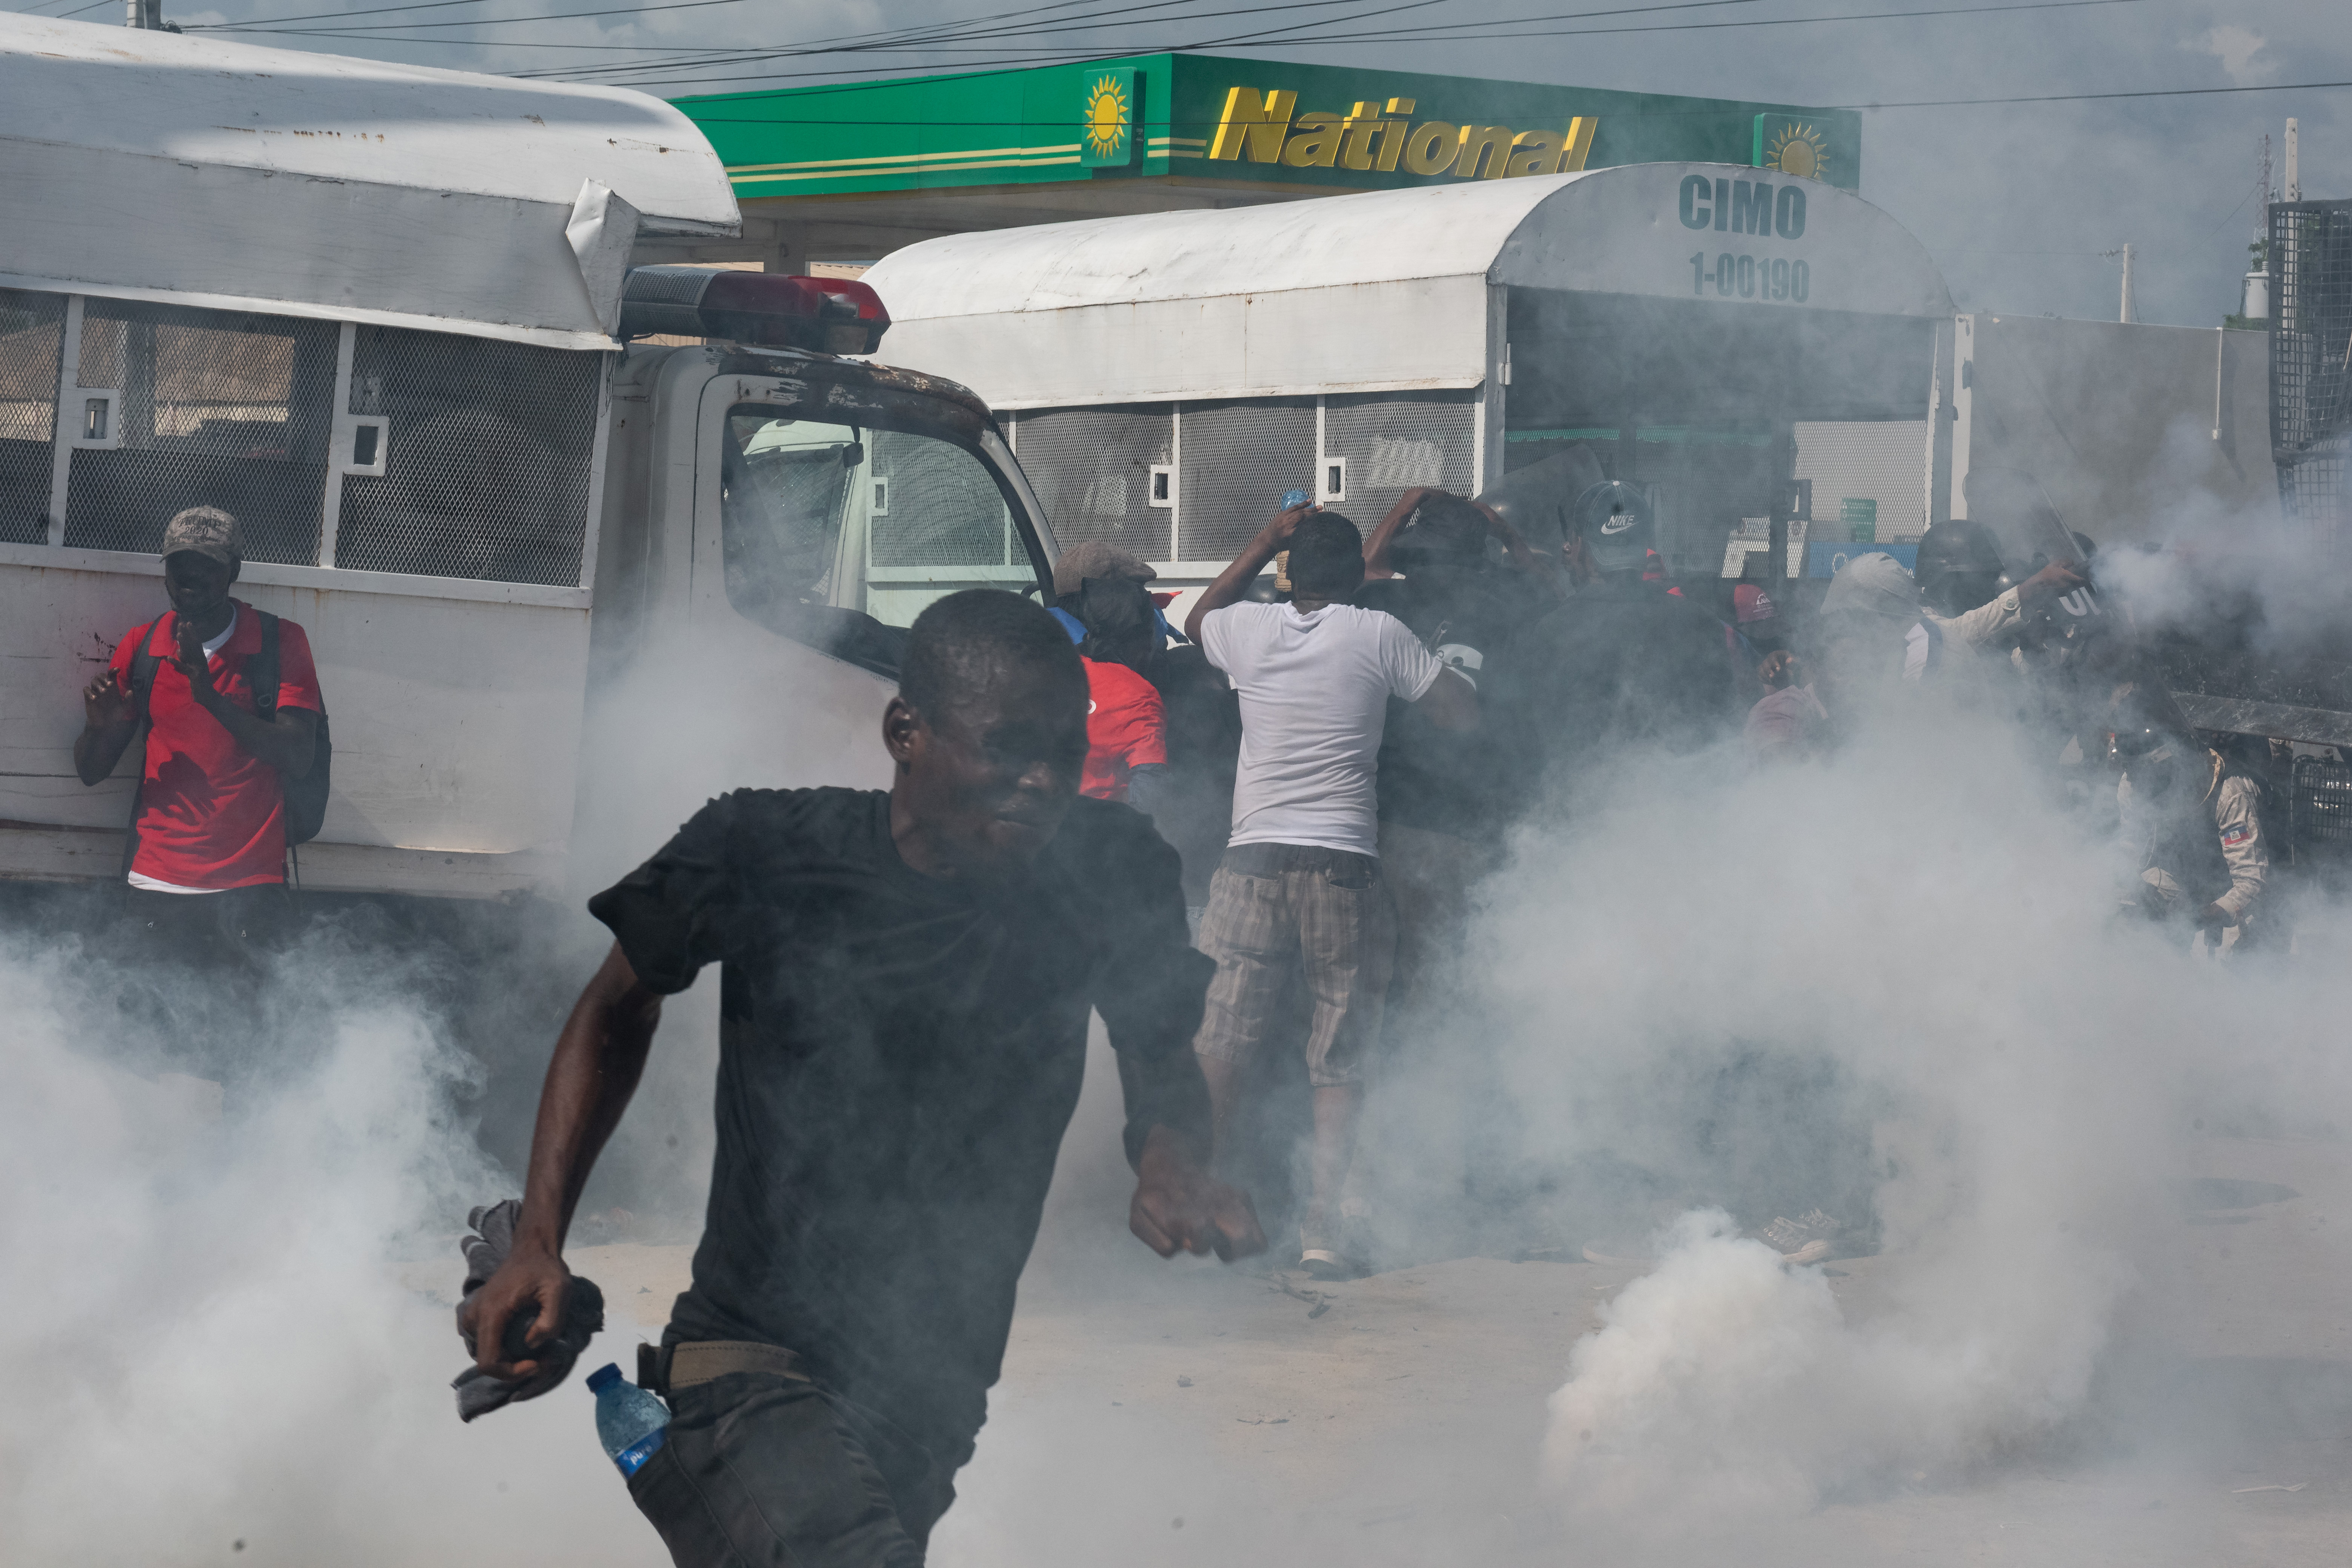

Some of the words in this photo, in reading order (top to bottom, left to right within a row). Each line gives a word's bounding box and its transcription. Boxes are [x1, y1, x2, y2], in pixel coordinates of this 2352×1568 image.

[1209, 86, 1598, 179] National
[1678, 174, 1806, 240] CIMO
[1689, 251, 1809, 303] 1-00190
[178, 515, 221, 528] TRUMP
[184, 526, 208, 535] 2020
[1607, 515, 1635, 526] NIKE
